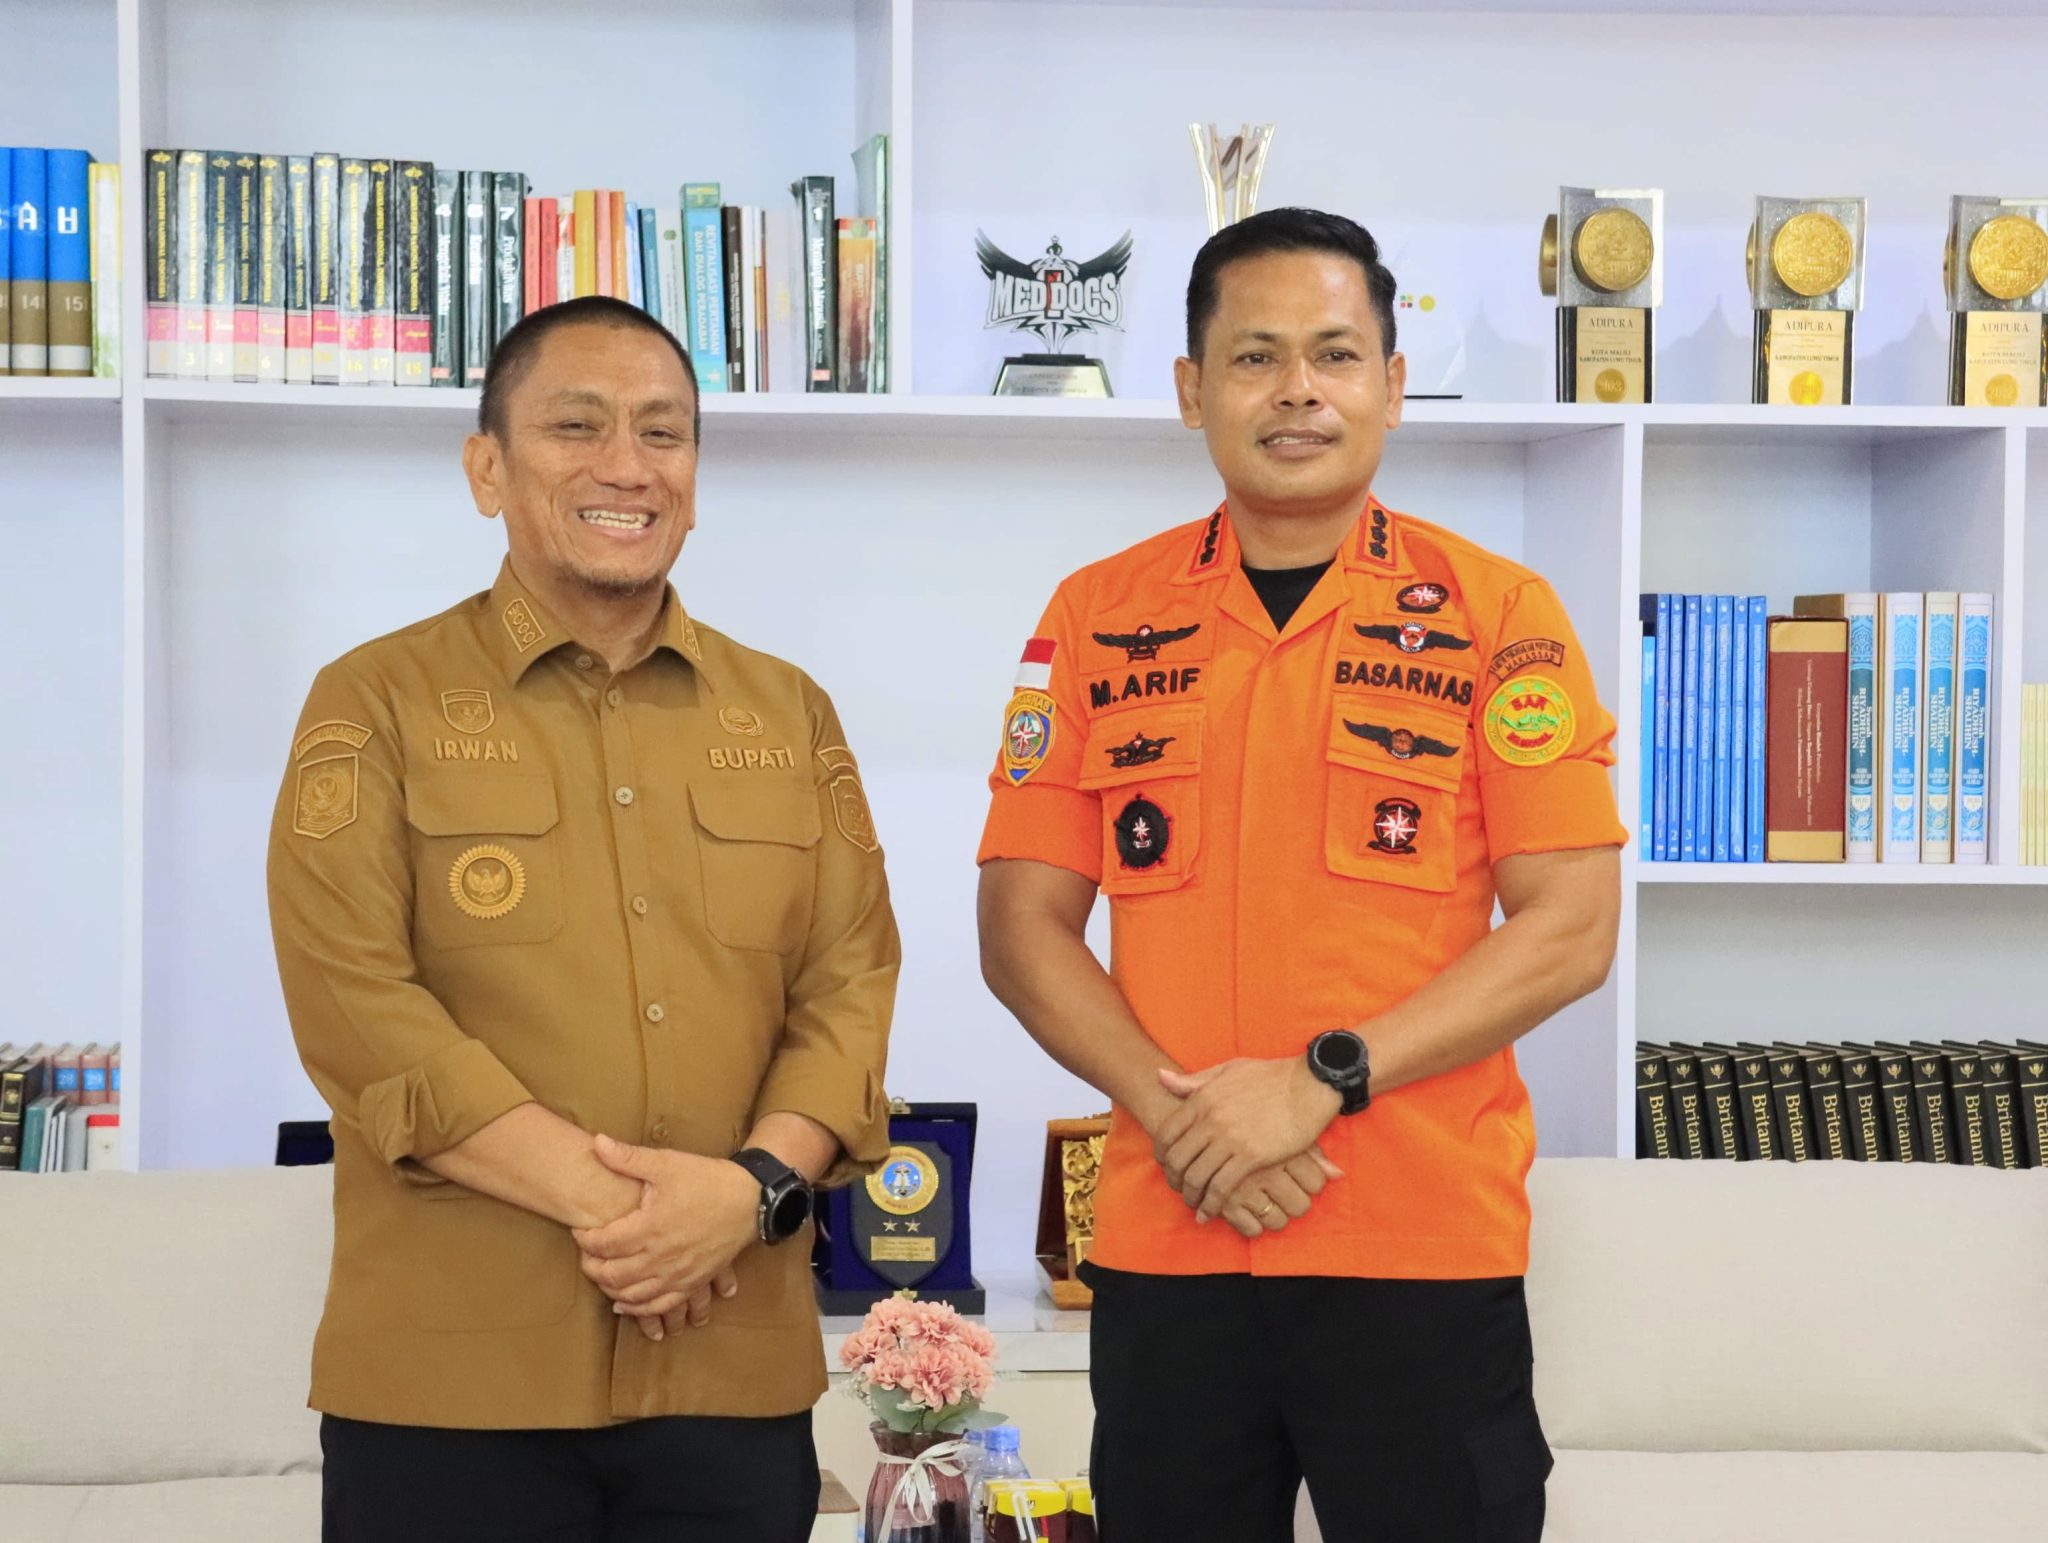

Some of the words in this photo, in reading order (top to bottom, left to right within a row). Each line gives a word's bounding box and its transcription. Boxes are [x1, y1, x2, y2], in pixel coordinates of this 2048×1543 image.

[500, 207, 515, 220] 7
[23, 295, 39, 310] 14
[990, 270, 1047, 322] MED
[1050, 271, 1119, 323] DOCS
[64, 296, 84, 312] 15
[1589, 317, 1634, 329] ADIPURA
[1784, 320, 1832, 331] ADIPURA
[1980, 322, 2029, 333] ADIPURA
[1505, 651, 1555, 672] MAKASSAR
[1090, 667, 1200, 709] M.ARIF
[1335, 660, 1473, 706] BASARNAS
[1511, 694, 1547, 711] SAR
[434, 738, 518, 761] IRWAN
[709, 747, 795, 769] BUPATI
[1671, 830, 1678, 840] 2
[1686, 829, 1693, 840] 3
[1700, 846, 1707, 856] 4
[1718, 845, 1725, 855] 5
[1734, 845, 1742, 855] 6
[1752, 844, 1759, 855] 7
